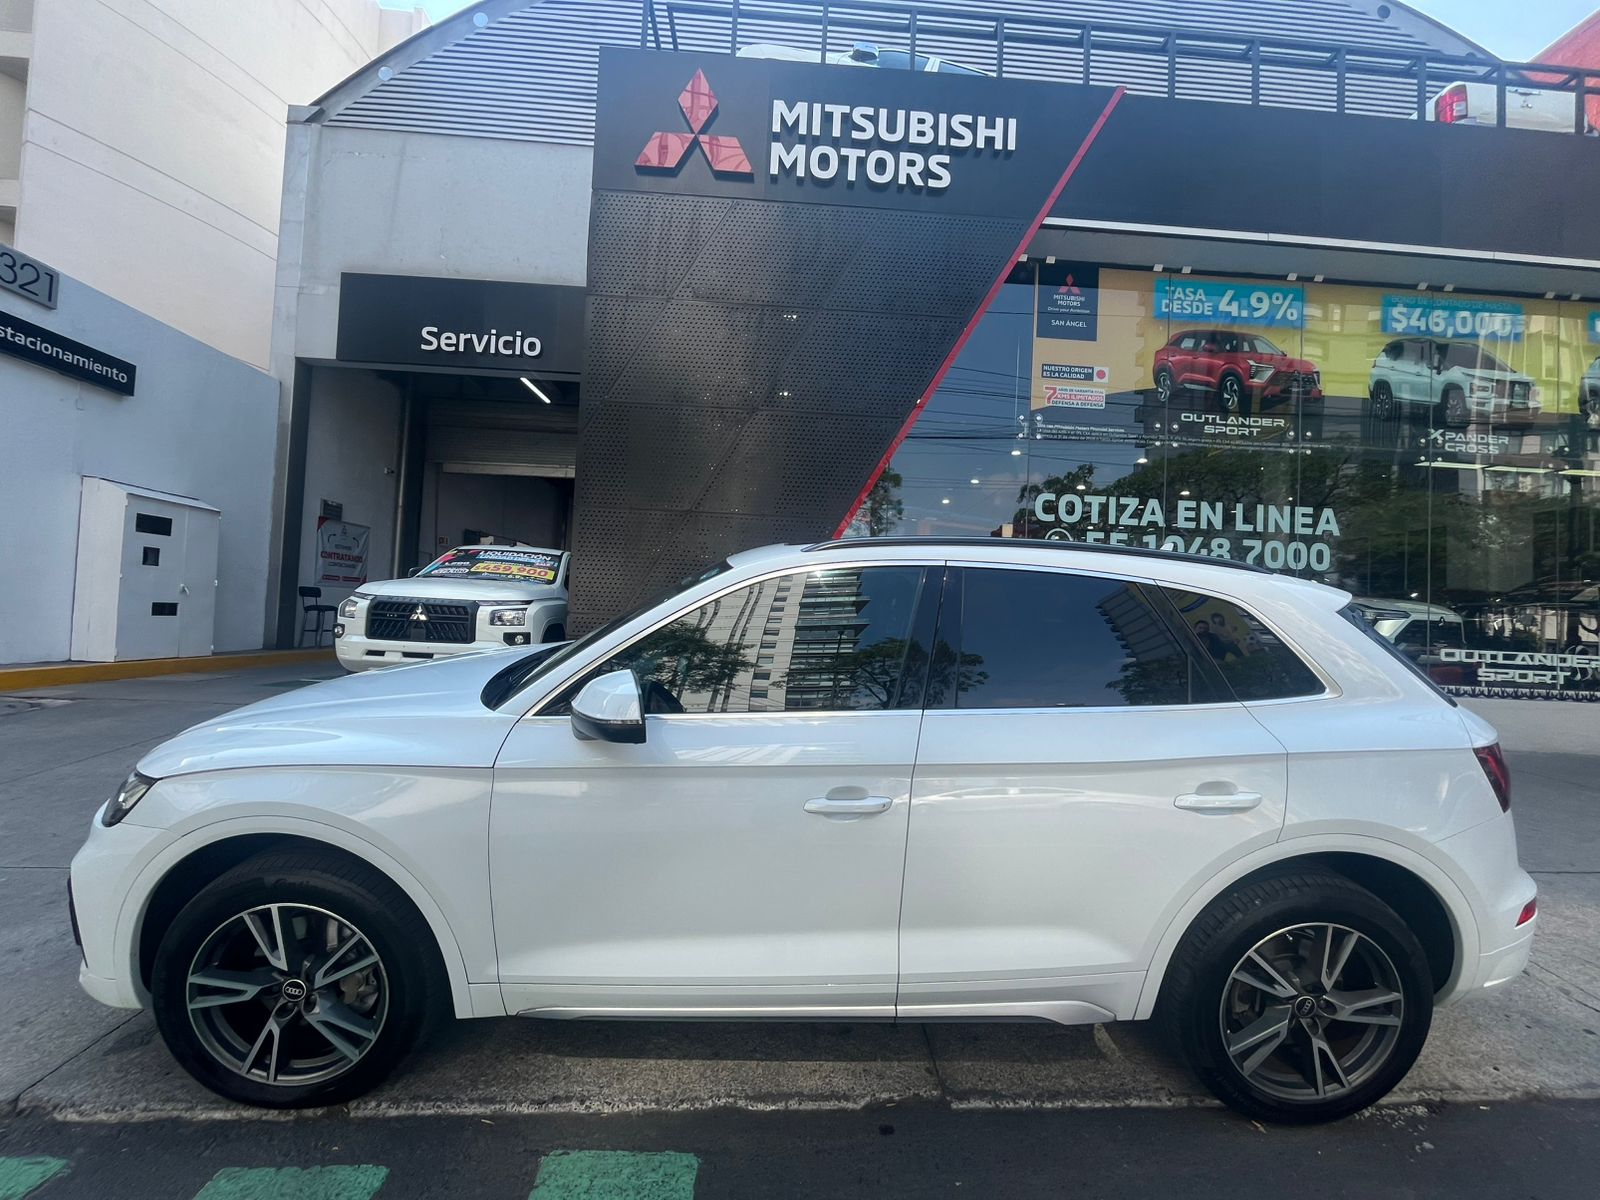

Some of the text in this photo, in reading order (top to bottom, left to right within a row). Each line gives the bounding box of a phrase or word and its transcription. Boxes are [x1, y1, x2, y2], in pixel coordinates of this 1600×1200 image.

[772, 100, 1017, 150] MITSUBISHI
[770, 142, 952, 188] MOTORS
[1165, 286, 1207, 301] TASA
[1162, 300, 1213, 315] DESDE
[1218, 290, 1298, 320] 4.9%
[1066, 319, 1087, 327] ÁNGEL
[1392, 304, 1512, 337] $46,000
[421, 326, 541, 356] Servicio
[1044, 387, 1057, 404] 7
[1181, 413, 1285, 427] OUTLANDER
[1204, 425, 1261, 436] SPORT
[1428, 428, 1509, 444] XPANDER
[1445, 443, 1499, 454] CROSS
[1034, 493, 1340, 536] COTIZA EN LINEA
[480, 550, 552, 560] LIQUIDACIÓN
[1242, 540, 1330, 572] 7000
[1477, 668, 1571, 684] SPORT
